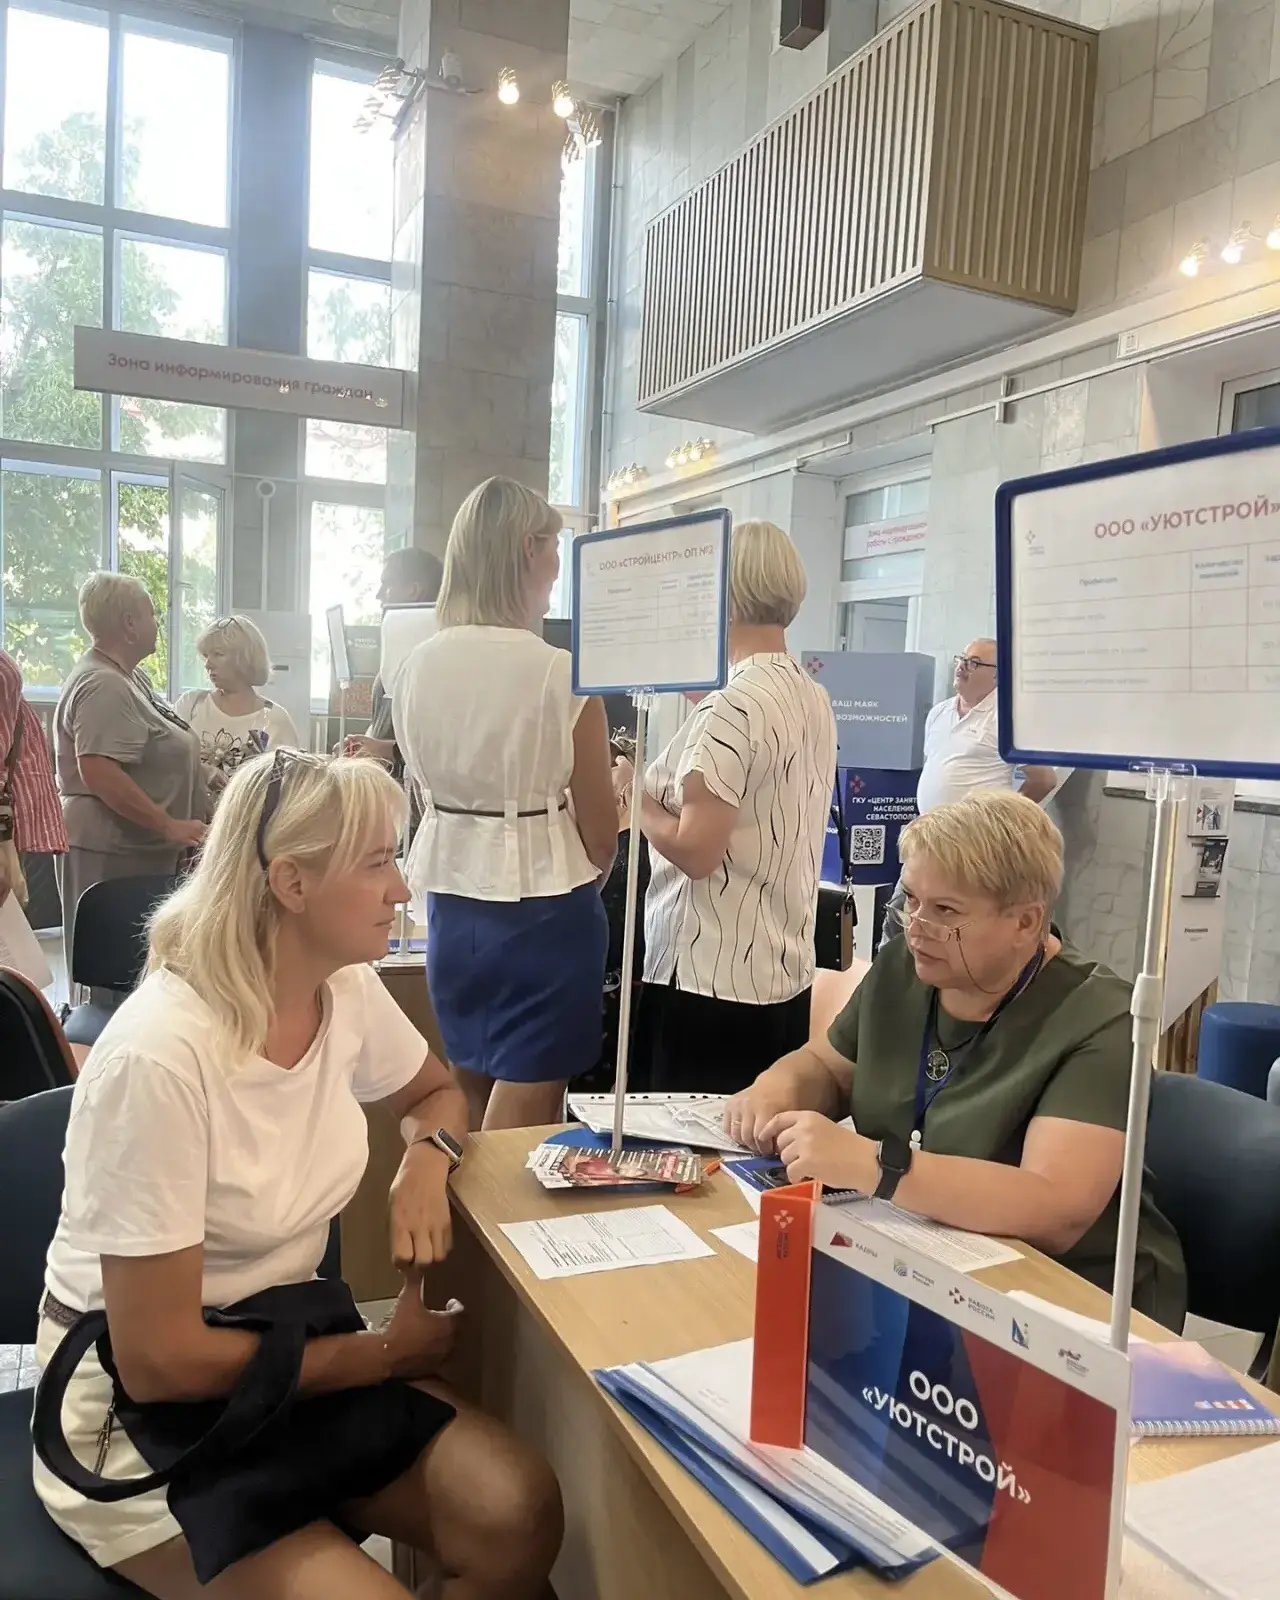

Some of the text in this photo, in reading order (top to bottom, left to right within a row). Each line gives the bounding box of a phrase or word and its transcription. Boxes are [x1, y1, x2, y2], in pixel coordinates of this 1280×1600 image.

[107, 352, 373, 401] Зона информирования граждан
[1094, 494, 1280, 539] ООО «УЮТСТРОЙ»
[599, 560, 618, 571] ООО
[684, 547, 697, 559] ОП
[832, 699, 879, 708] ВАШ МАЯК
[836, 713, 908, 723] ВОЗМОЖНОСТЕЙ
[867, 797, 894, 805] «ЦЕНТР
[909, 1370, 979, 1431] ООО
[862, 1386, 1032, 1504] «УЮТСТРОЙ»
